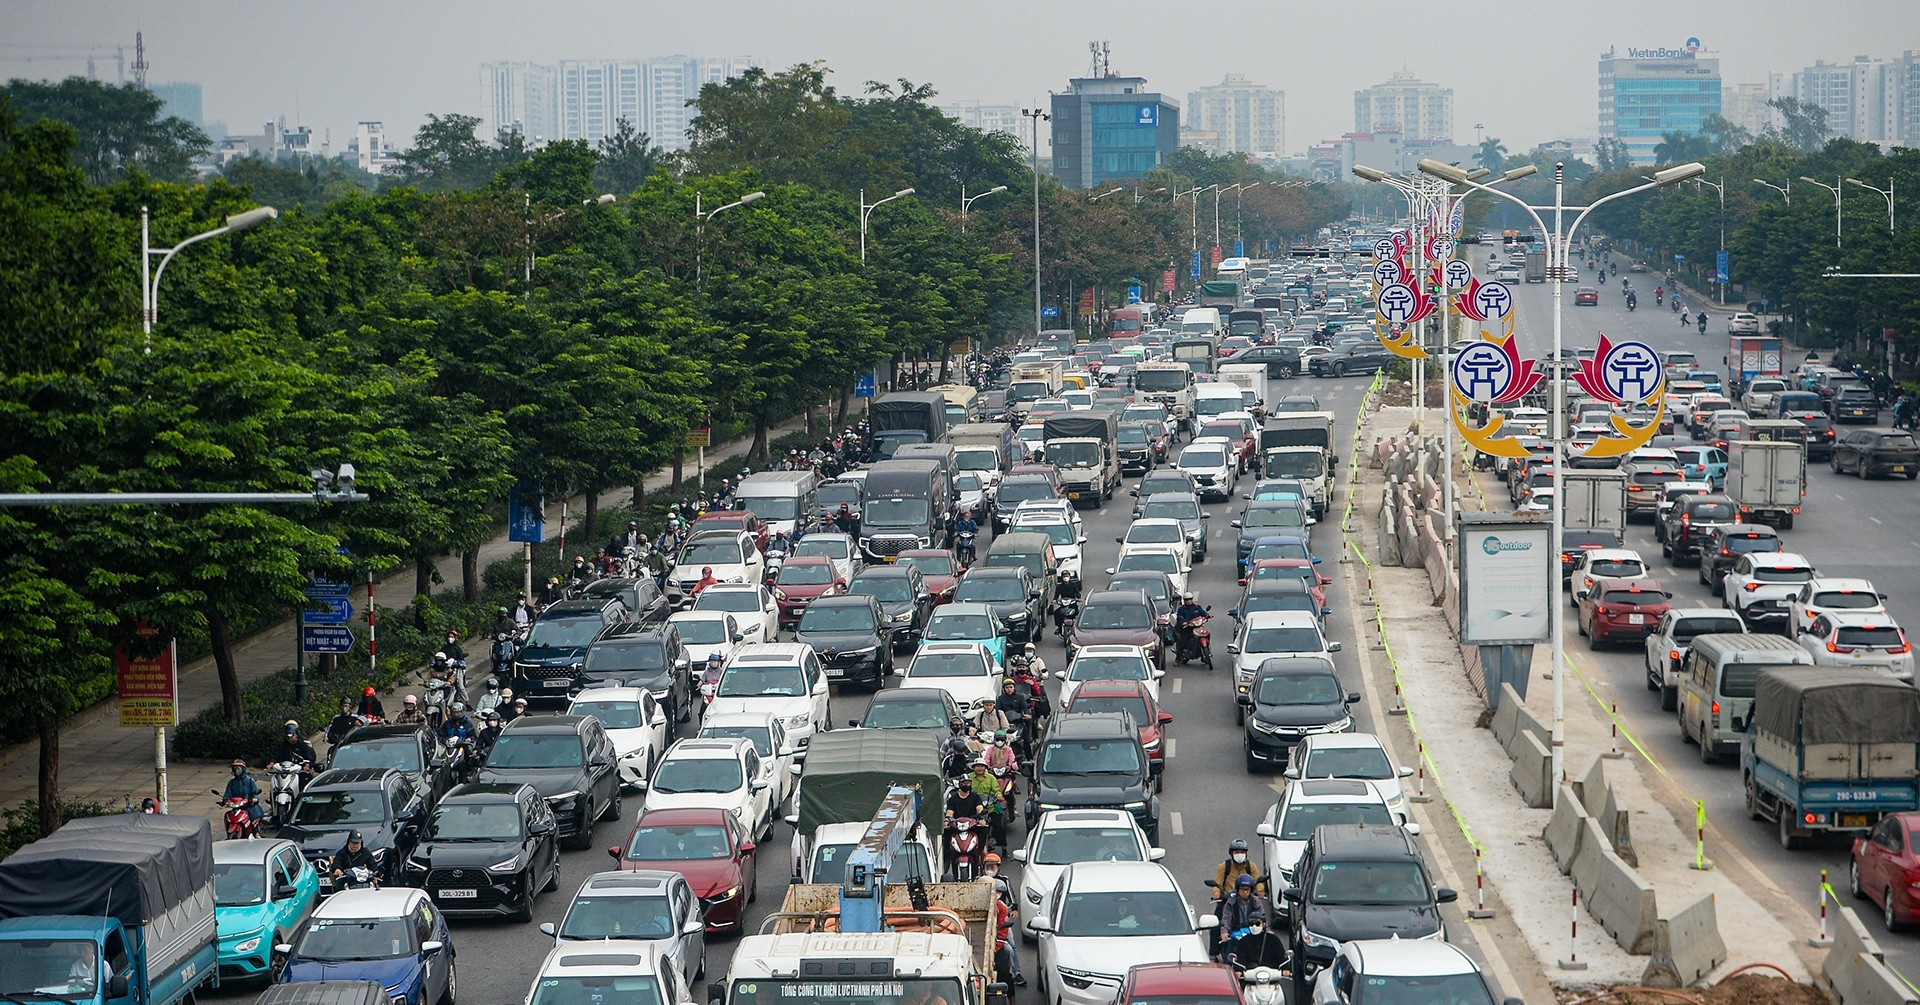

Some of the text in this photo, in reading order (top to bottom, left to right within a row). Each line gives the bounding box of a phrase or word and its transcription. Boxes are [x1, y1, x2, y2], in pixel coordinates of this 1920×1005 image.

[1628, 47, 1686, 59] VietinBank
[305, 636, 316, 646] VIỆT
[316, 636, 329, 646] NHẬT
[333, 636, 340, 645] HÀ
[340, 636, 350, 647] NỘI
[781, 983, 797, 997] TỔNG
[798, 983, 814, 997] CÔNG
[815, 985, 823, 997] TY
[823, 983, 837, 998] ĐIỆN
[851, 983, 871, 997] THÀNH
[871, 982, 884, 997] PHỐ
[884, 983, 893, 997] HÀ
[893, 984, 904, 998] NỘI
